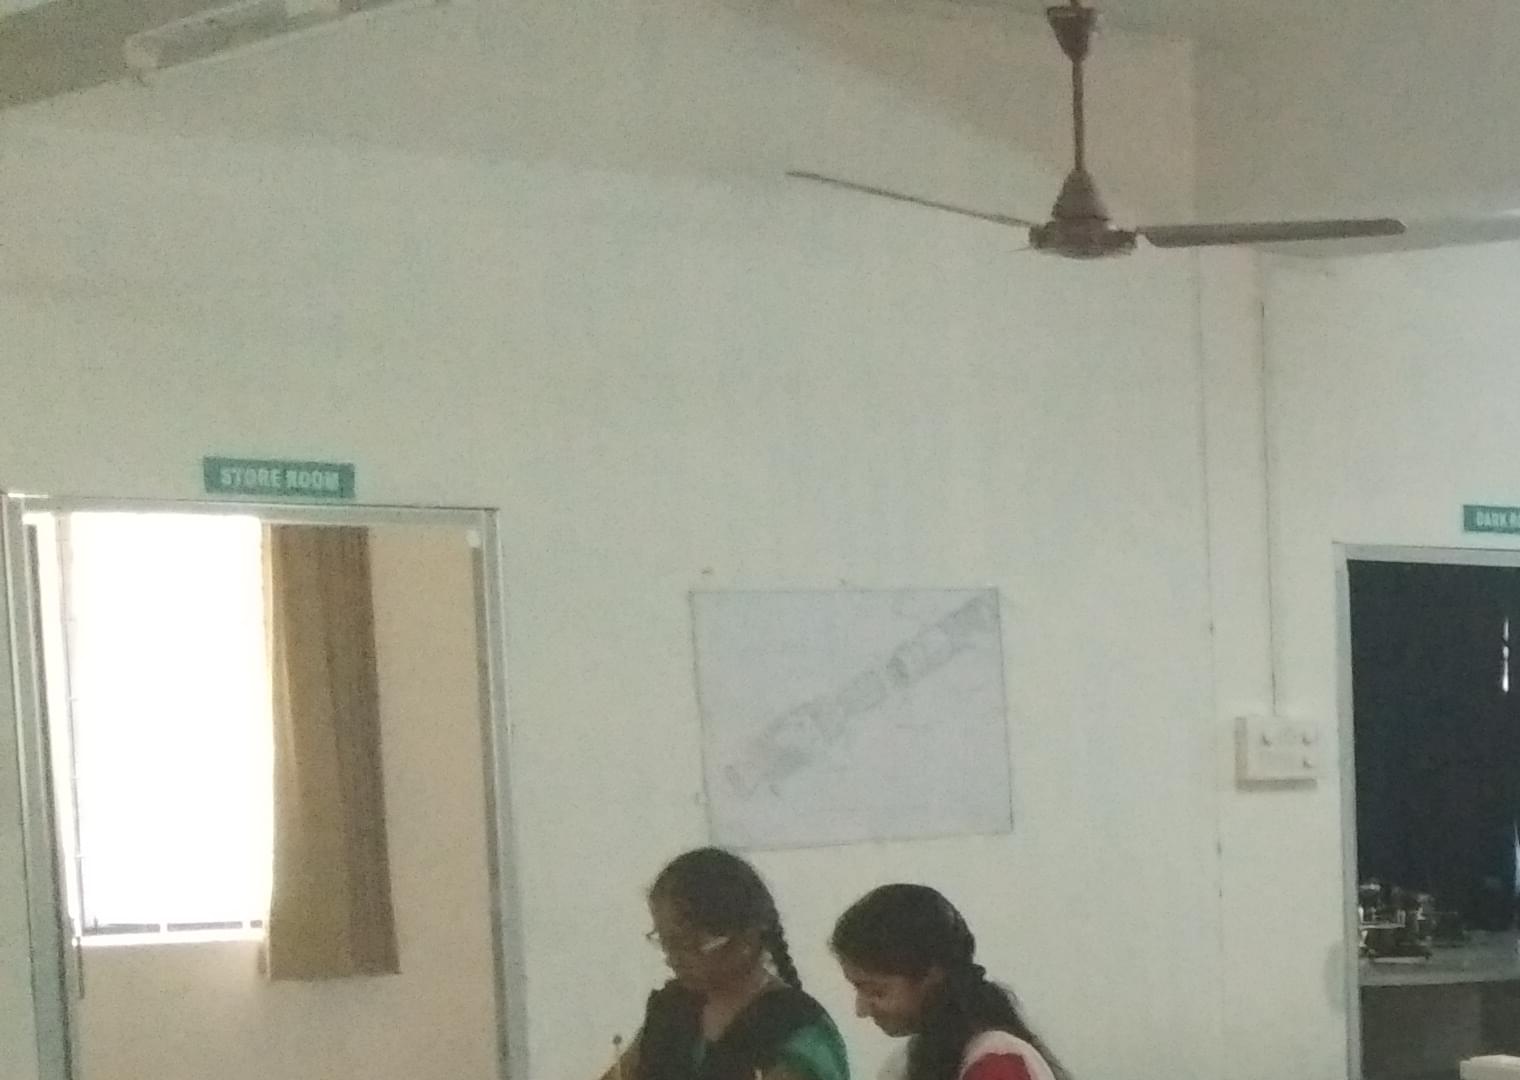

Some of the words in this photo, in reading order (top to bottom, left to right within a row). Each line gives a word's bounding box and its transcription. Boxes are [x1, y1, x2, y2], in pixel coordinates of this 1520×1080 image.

[220, 466, 281, 489] STORE
[286, 469, 340, 492] ROOM
[1476, 511, 1507, 528] DARK
